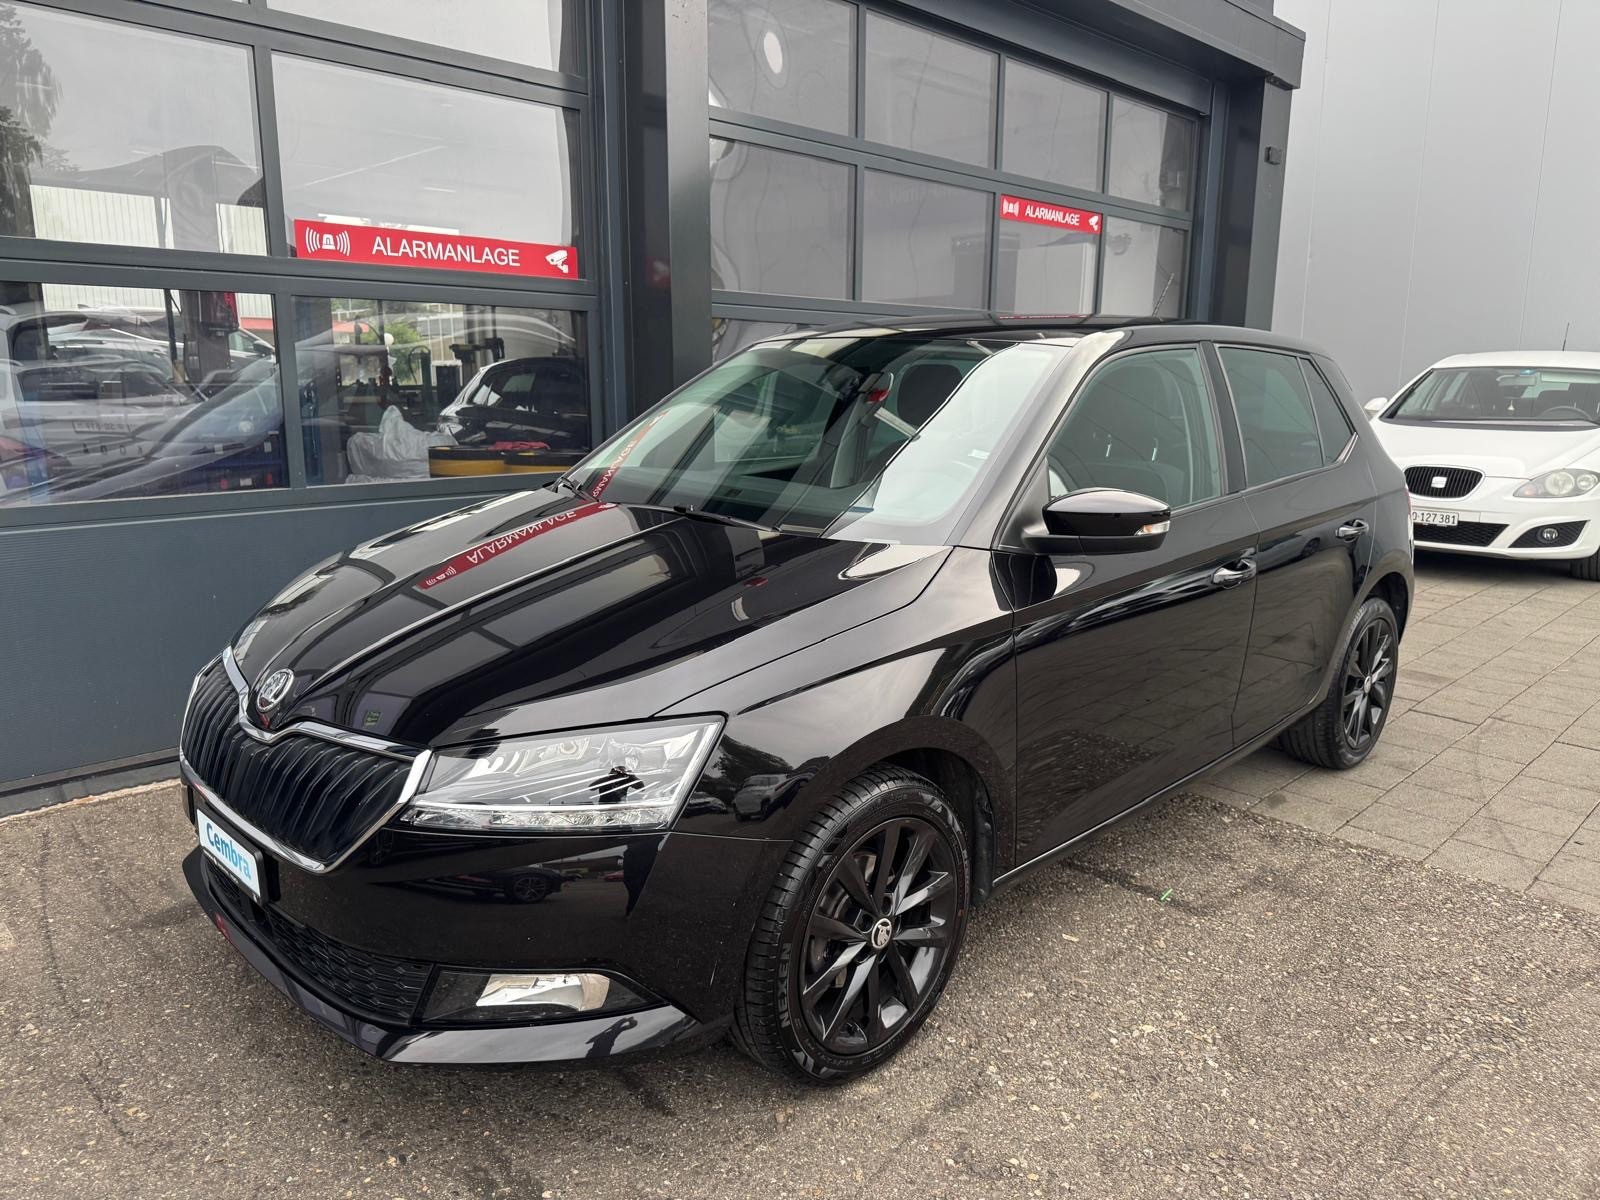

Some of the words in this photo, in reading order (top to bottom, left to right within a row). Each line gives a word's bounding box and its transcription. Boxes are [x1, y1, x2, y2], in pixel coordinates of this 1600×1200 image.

[1025, 205, 1080, 225] ALARMANLAGE
[371, 236, 521, 267] ALARMANLAGE
[207, 823, 251, 880] Cembra
[778, 942, 792, 1028] NEXEN
